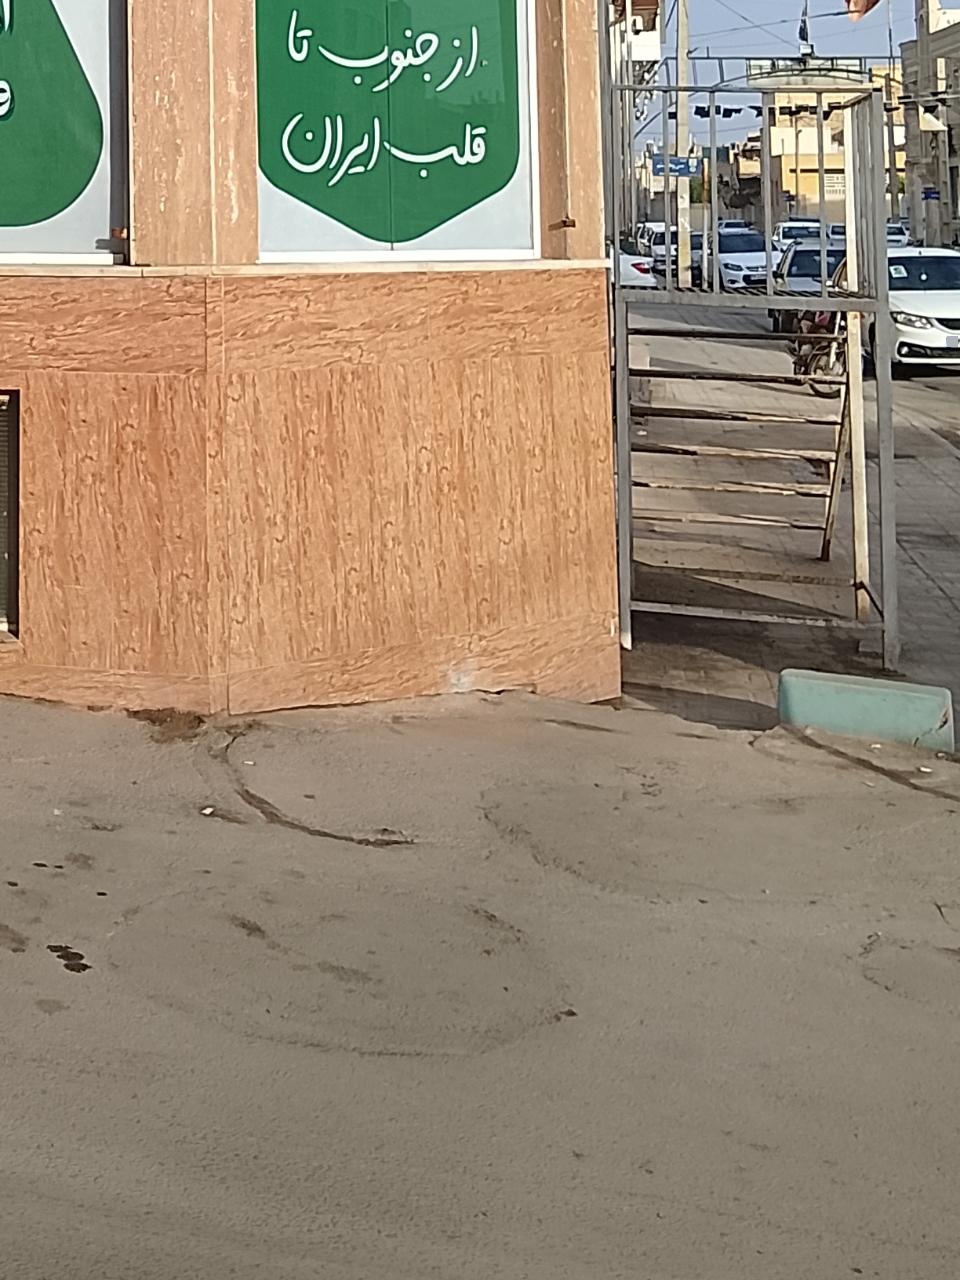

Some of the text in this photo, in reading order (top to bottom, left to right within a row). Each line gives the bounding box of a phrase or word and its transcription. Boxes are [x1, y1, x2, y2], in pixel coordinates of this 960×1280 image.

[287, 9, 478, 92] از جنوب تا
[281, 113, 488, 187] قلب ایران
